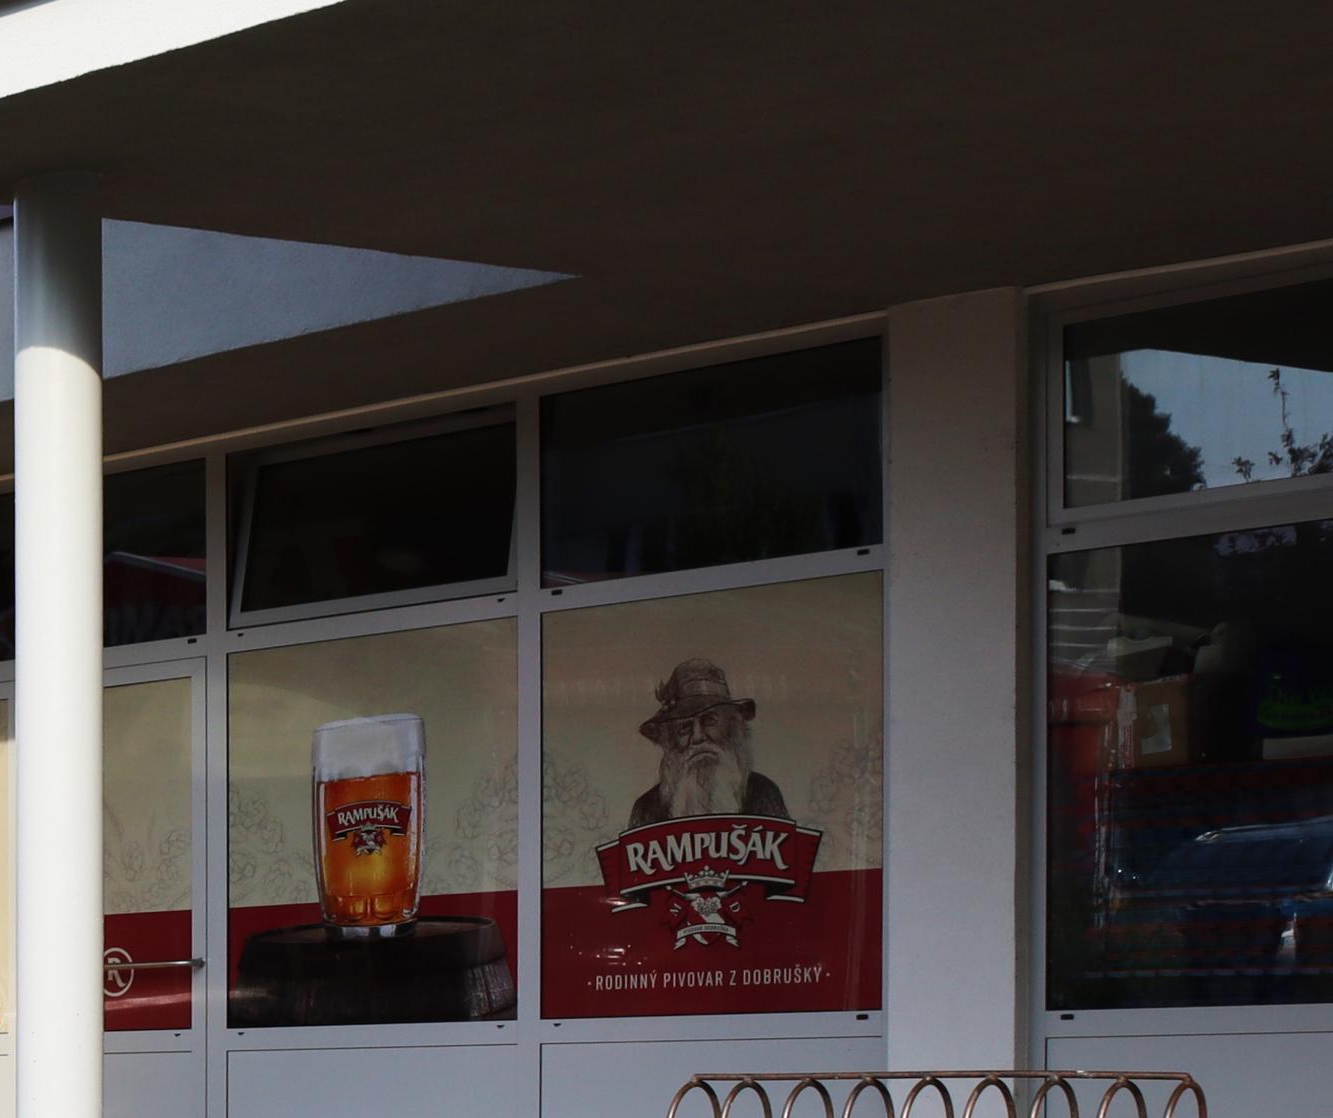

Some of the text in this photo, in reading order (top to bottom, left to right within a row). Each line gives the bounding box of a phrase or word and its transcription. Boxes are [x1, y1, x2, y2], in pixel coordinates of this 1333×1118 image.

[337, 804, 400, 827] RAMPUŠÁK
[626, 824, 790, 876] RAMPUŠÁK
[595, 963, 822, 991] RODINNÝ PIVOVAR Z DOBRUŠKY
